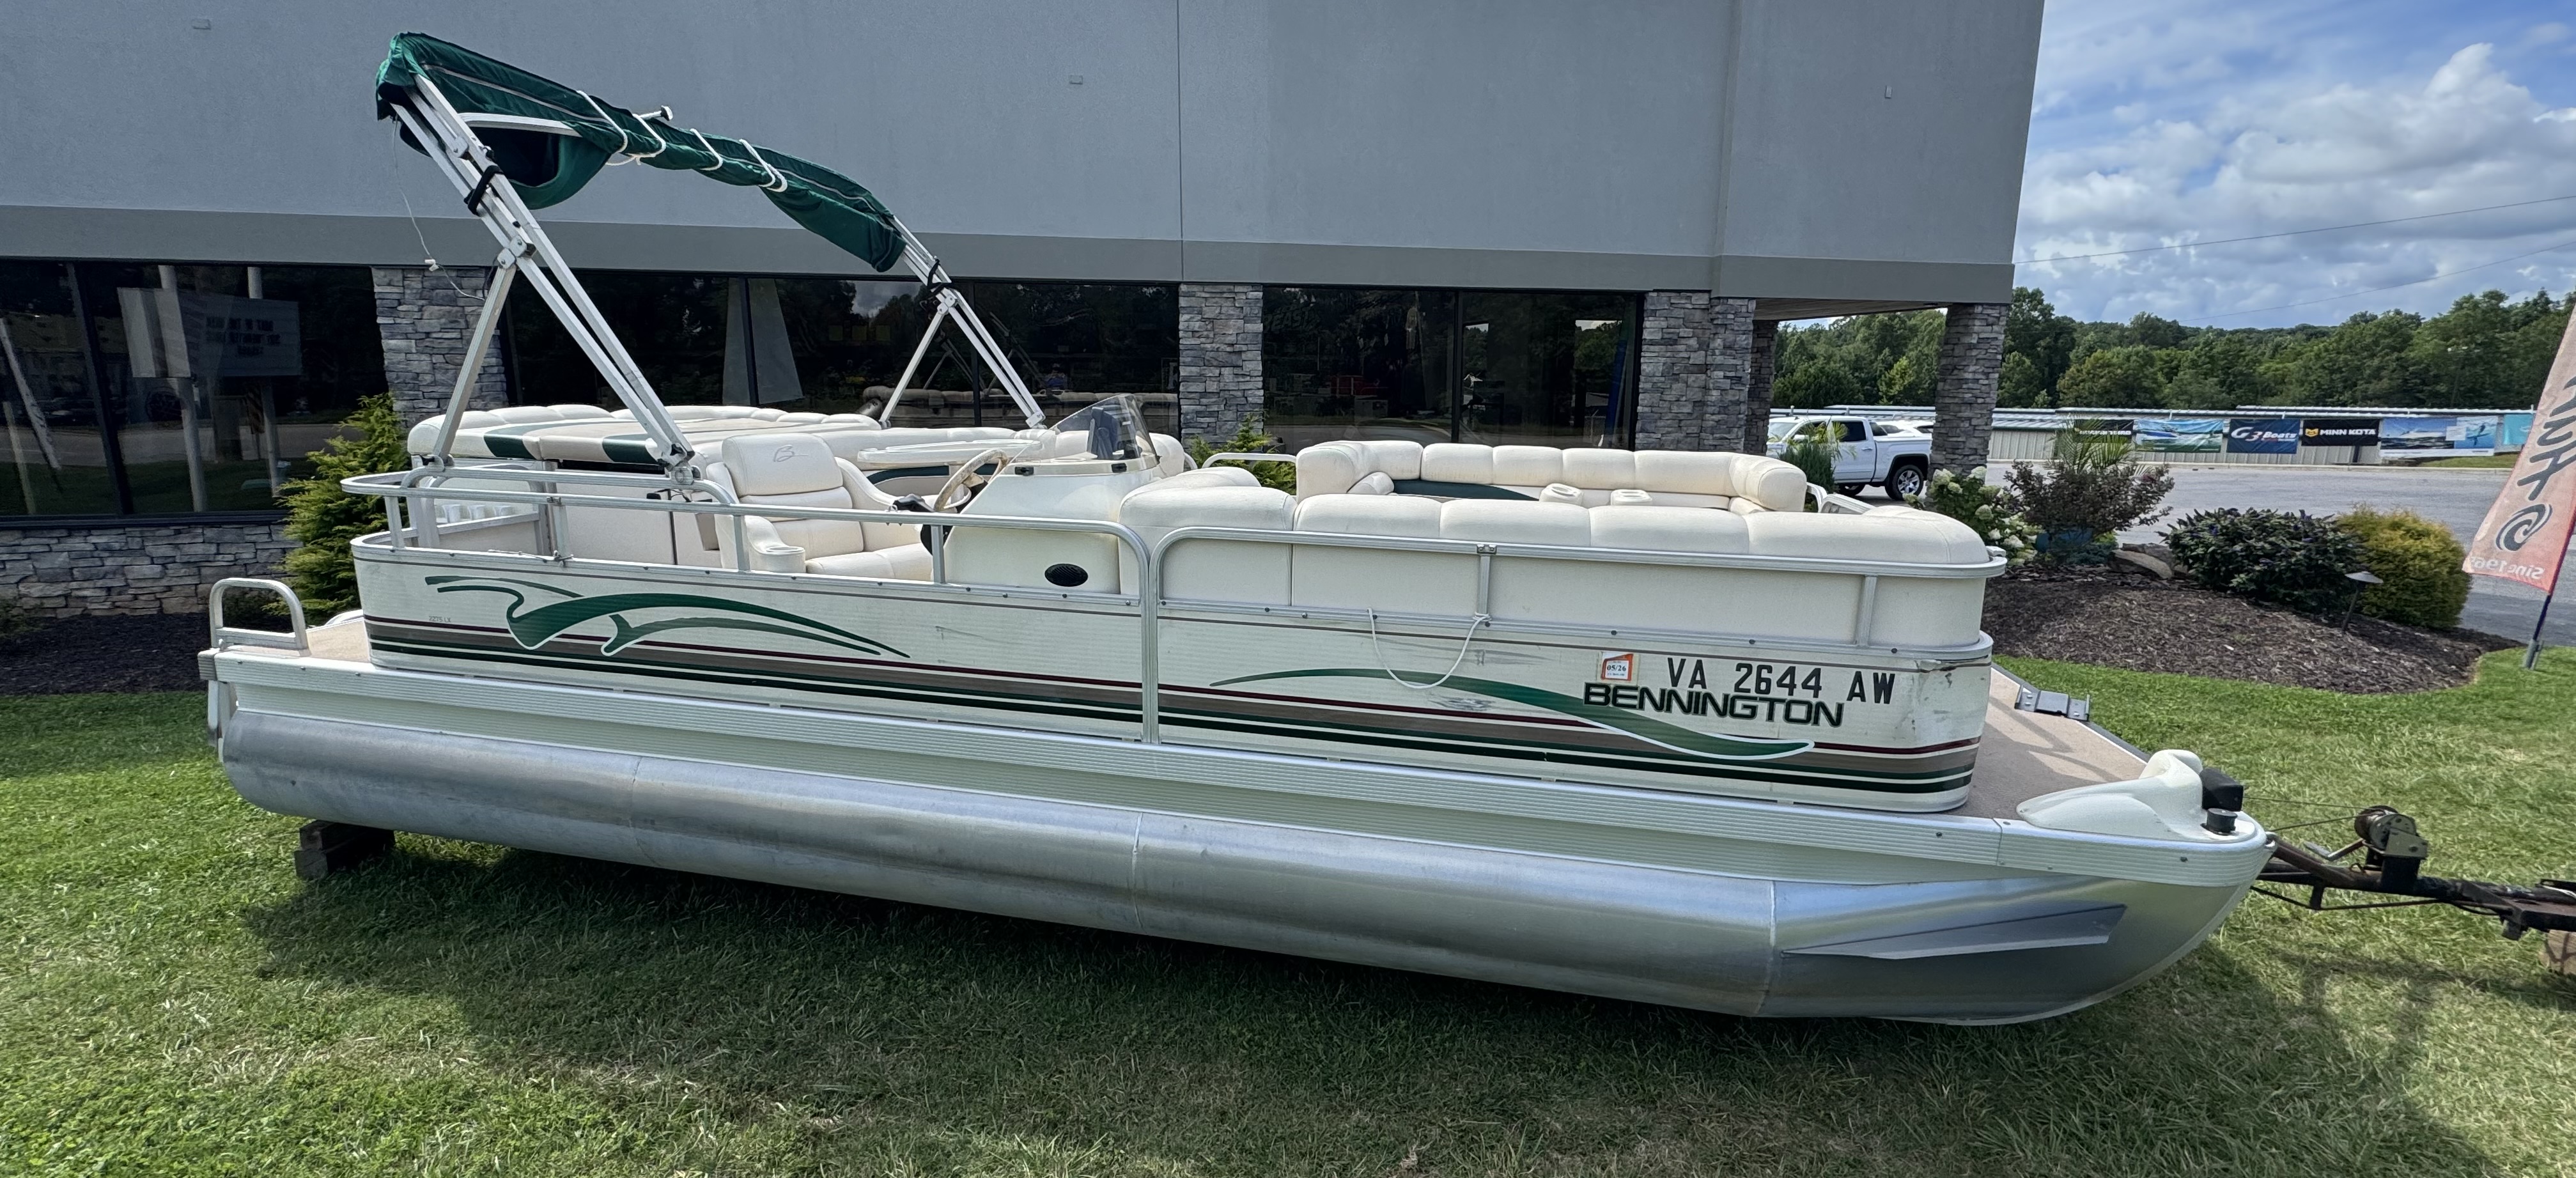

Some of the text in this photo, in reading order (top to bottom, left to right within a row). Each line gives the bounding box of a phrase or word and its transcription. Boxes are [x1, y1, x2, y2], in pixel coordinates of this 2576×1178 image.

[1667, 657, 1895, 704] VA 2644 AW
[1583, 682, 1845, 728] BENNINGTON
